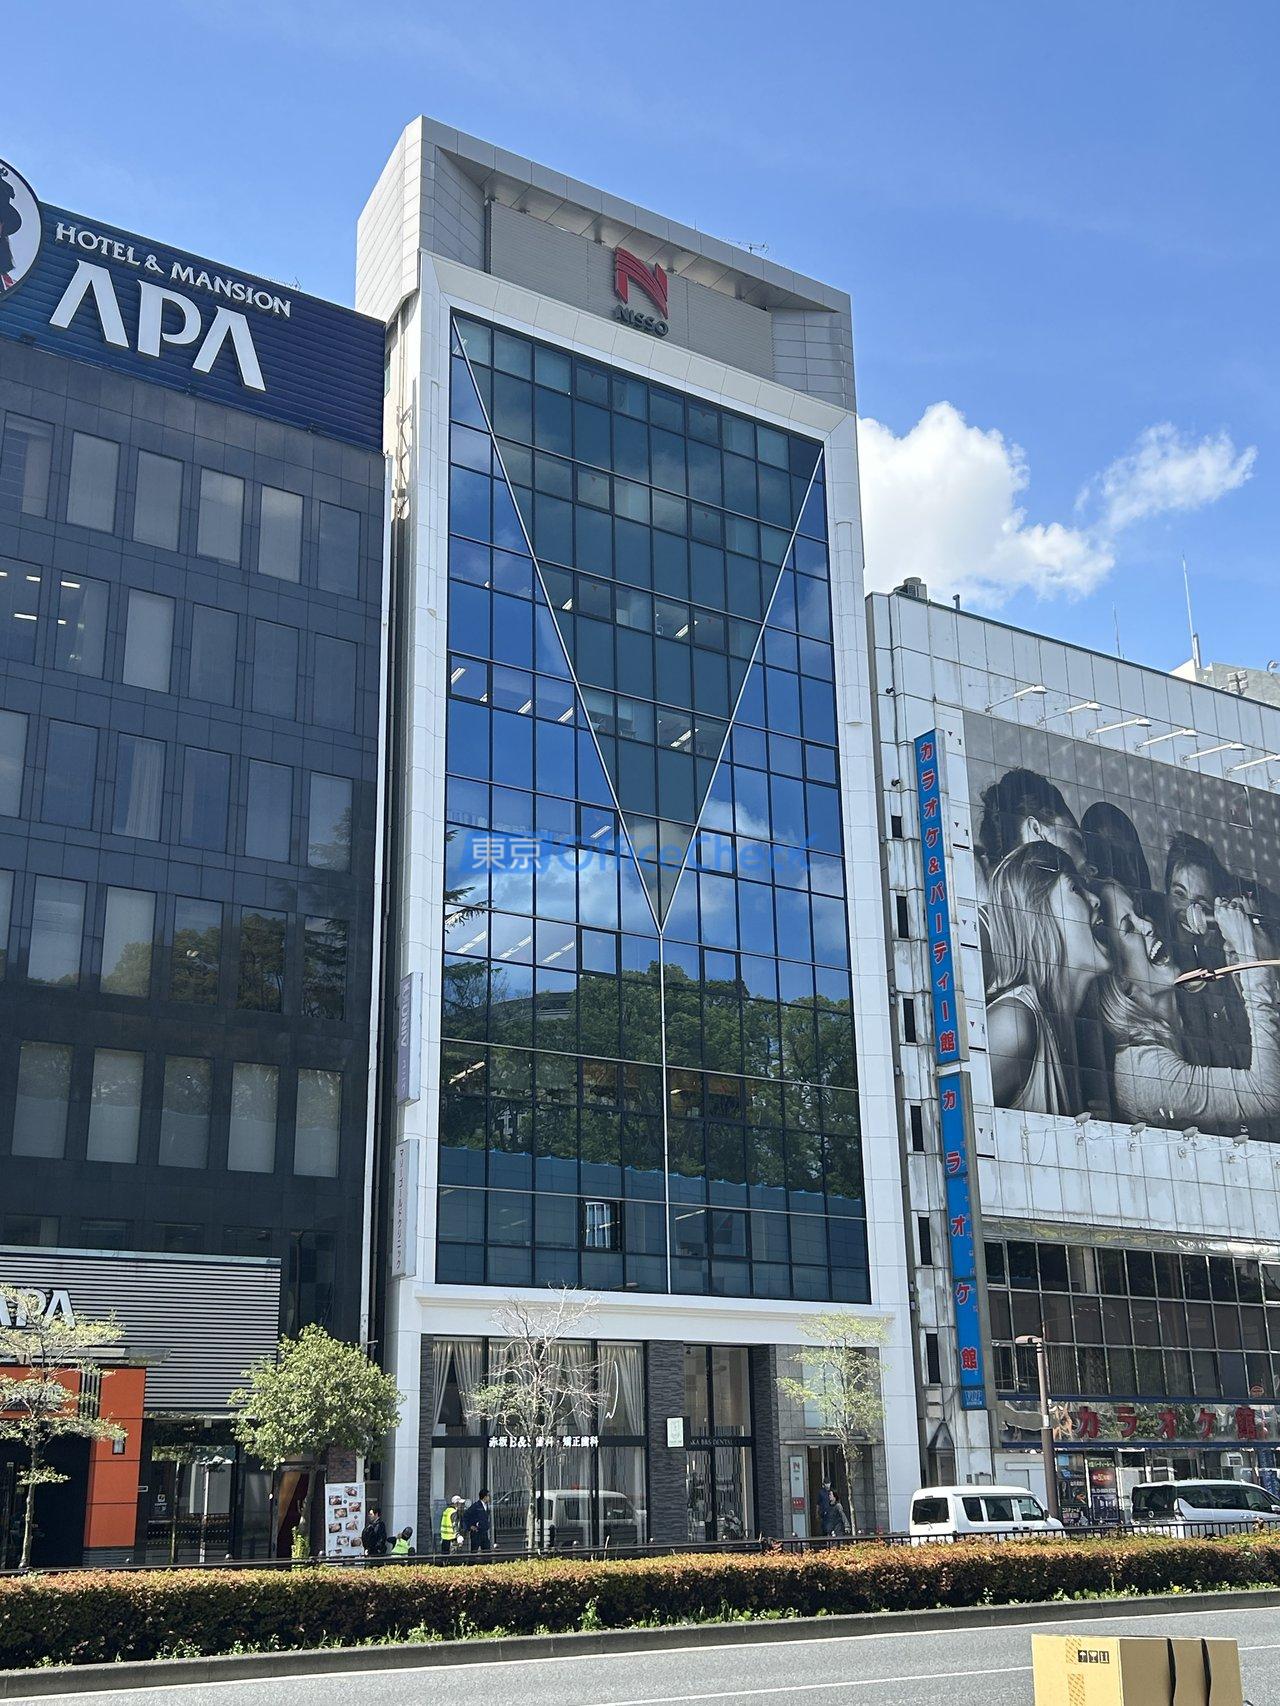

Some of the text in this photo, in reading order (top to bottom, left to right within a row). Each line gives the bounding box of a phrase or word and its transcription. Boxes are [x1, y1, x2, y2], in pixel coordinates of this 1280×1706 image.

[49, 259, 267, 392] APA
[55, 222, 292, 317] HOTEL & MANSION
[614, 304, 669, 336] NISSO
[919, 742, 956, 1053] カラオケ&パーティー館
[943, 1089, 978, 1371] カラオケ館
[1076, 1404, 1257, 1439] カラオケ館
